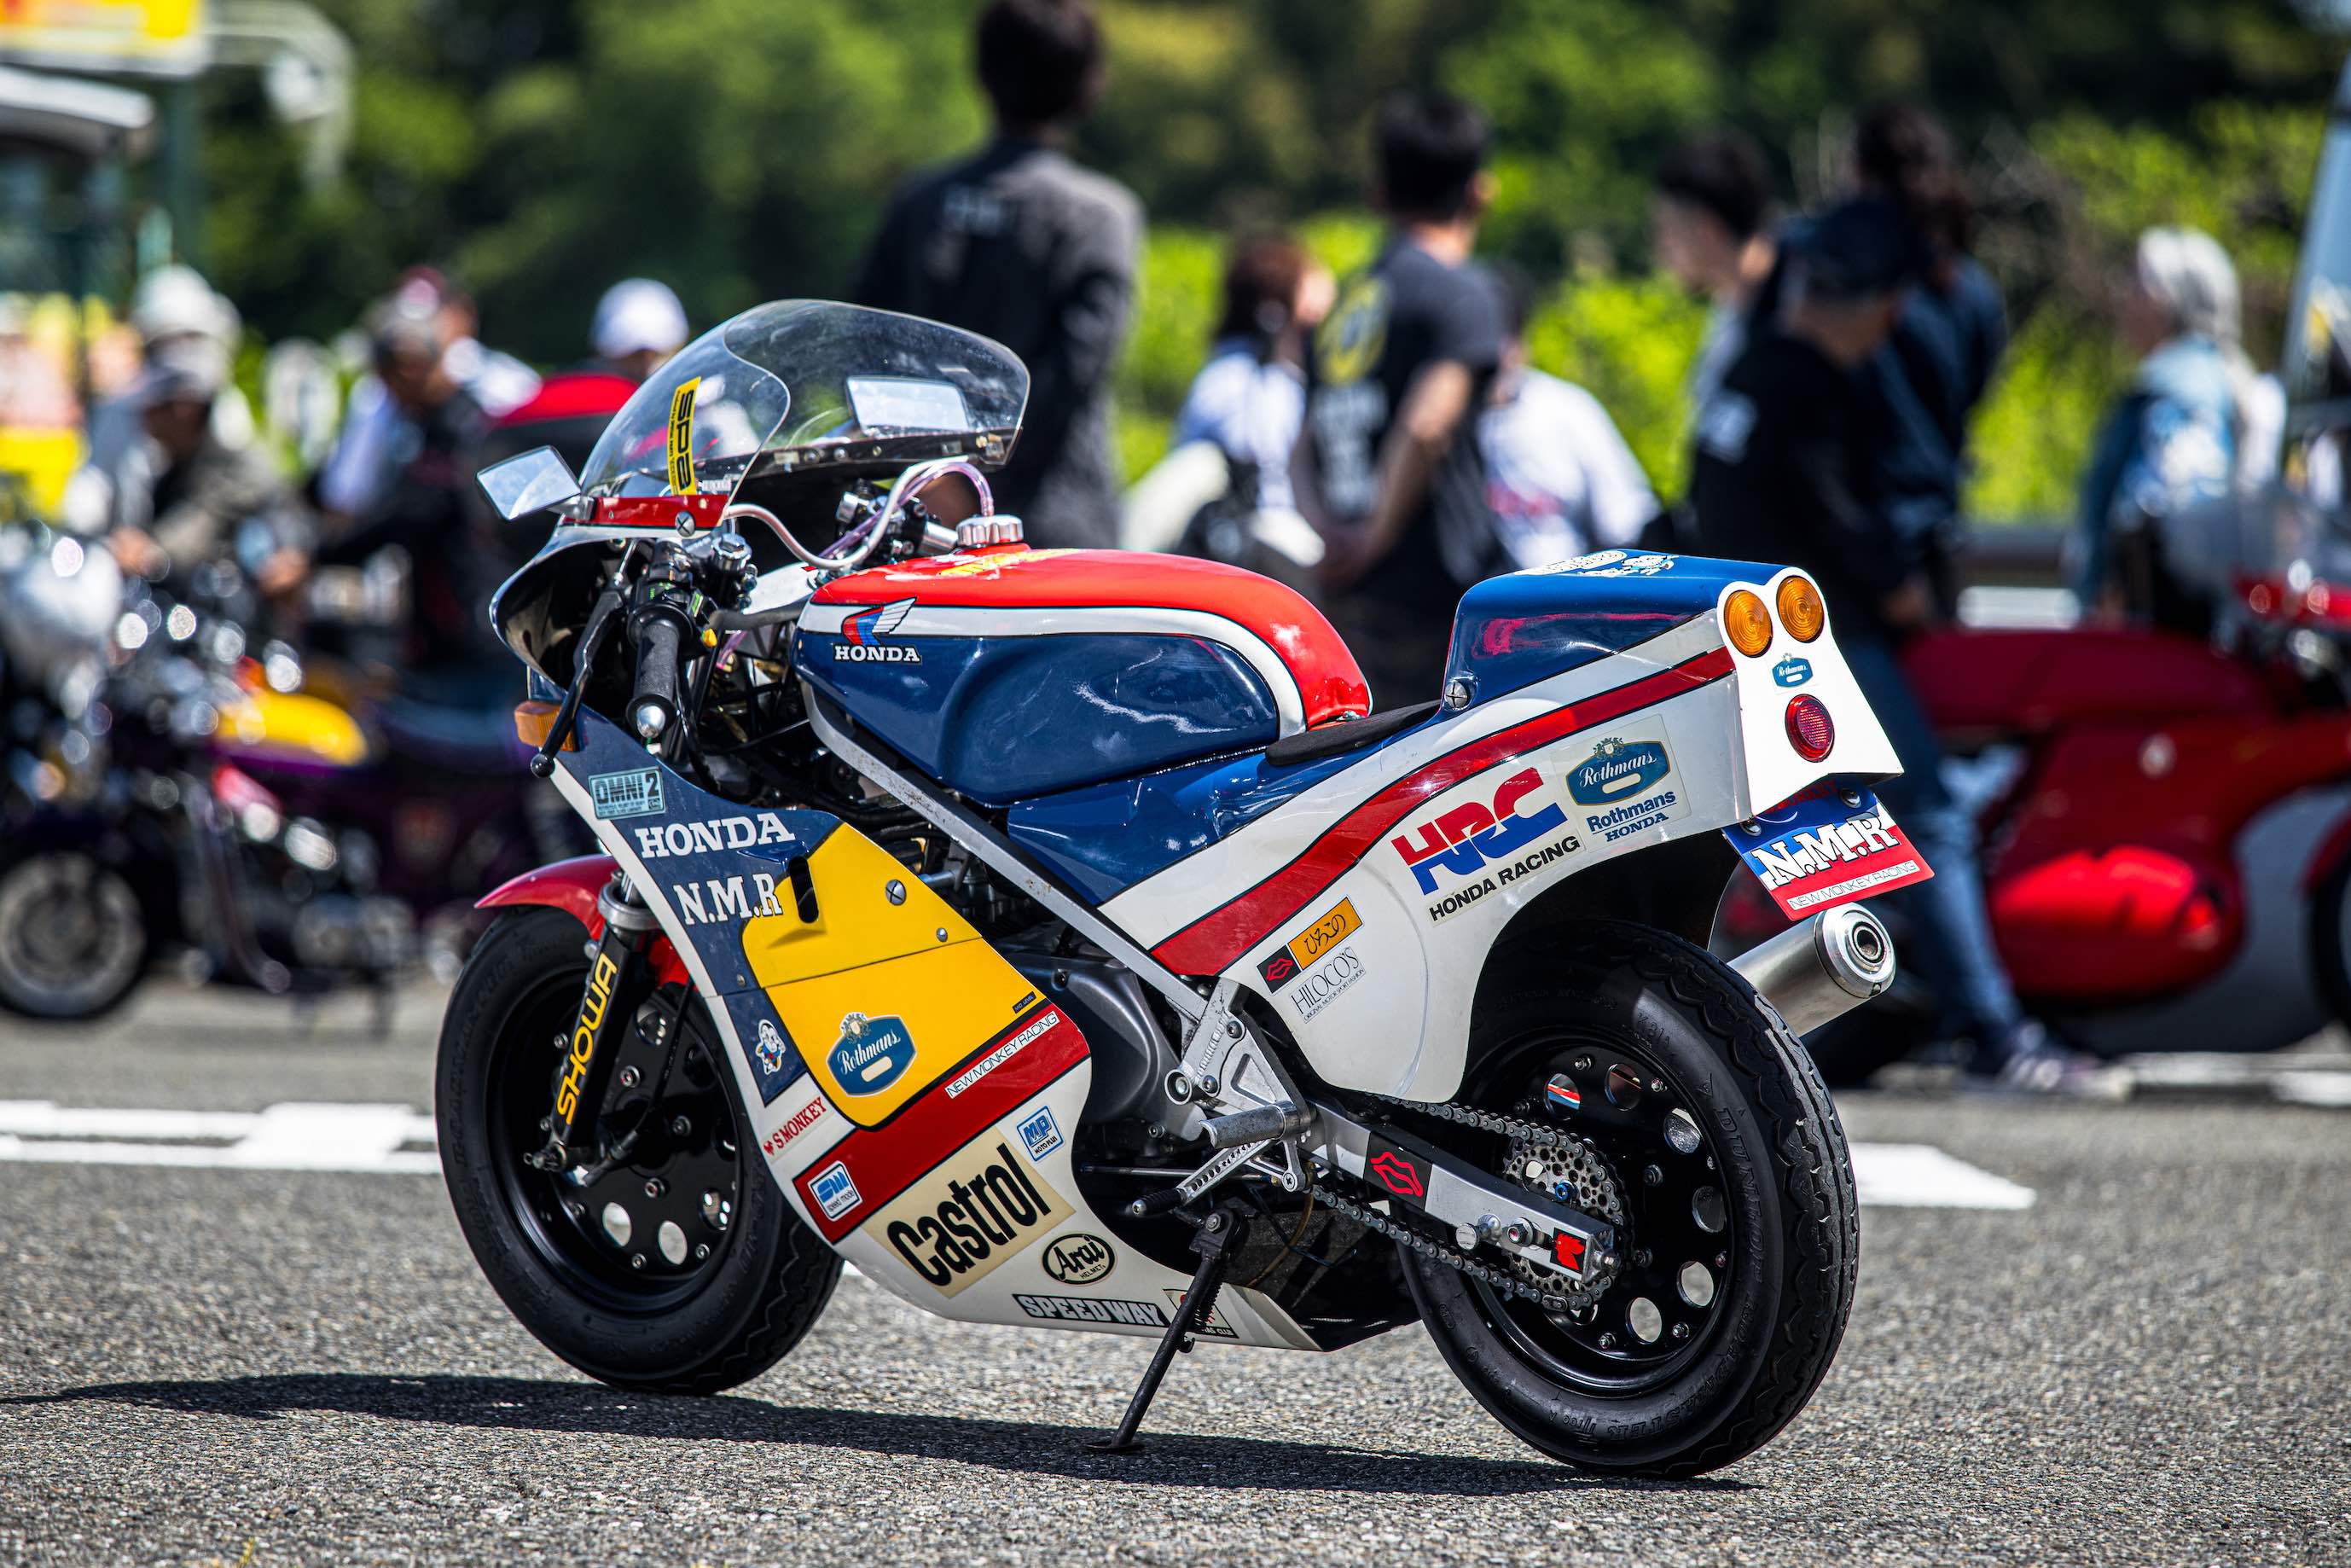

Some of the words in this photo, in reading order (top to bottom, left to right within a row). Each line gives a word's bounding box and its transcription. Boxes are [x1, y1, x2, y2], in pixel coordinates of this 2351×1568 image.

[834, 646, 920, 662] HONDA
[645, 772, 659, 797] 2
[1579, 752, 1657, 787] Rothmans
[634, 812, 796, 859] HONDA
[1390, 767, 1568, 896] HRC
[1586, 791, 1676, 833] Rothmans
[1605, 812, 1669, 842] HONDA
[672, 873, 783, 925] N.M.R
[1429, 878, 1498, 921] HONDA
[1497, 835, 1581, 886] RACING
[1790, 891, 1821, 909] NEW
[1821, 877, 1872, 901] MONKEY
[1872, 862, 1916, 886] RACING
[1291, 947, 1359, 1014] HILOCO'S
[557, 953, 618, 1125] SHOWA
[837, 1028, 901, 1075] Rothmans
[947, 1072, 973, 1096] NEW
[972, 1039, 1018, 1078] MONKEY
[1017, 1013, 1057, 1046] RACING
[886, 1142, 1052, 1286] Castrol
[1053, 1235, 1106, 1281] Arai
[1017, 1296, 1164, 1327] SPEEDWAY
